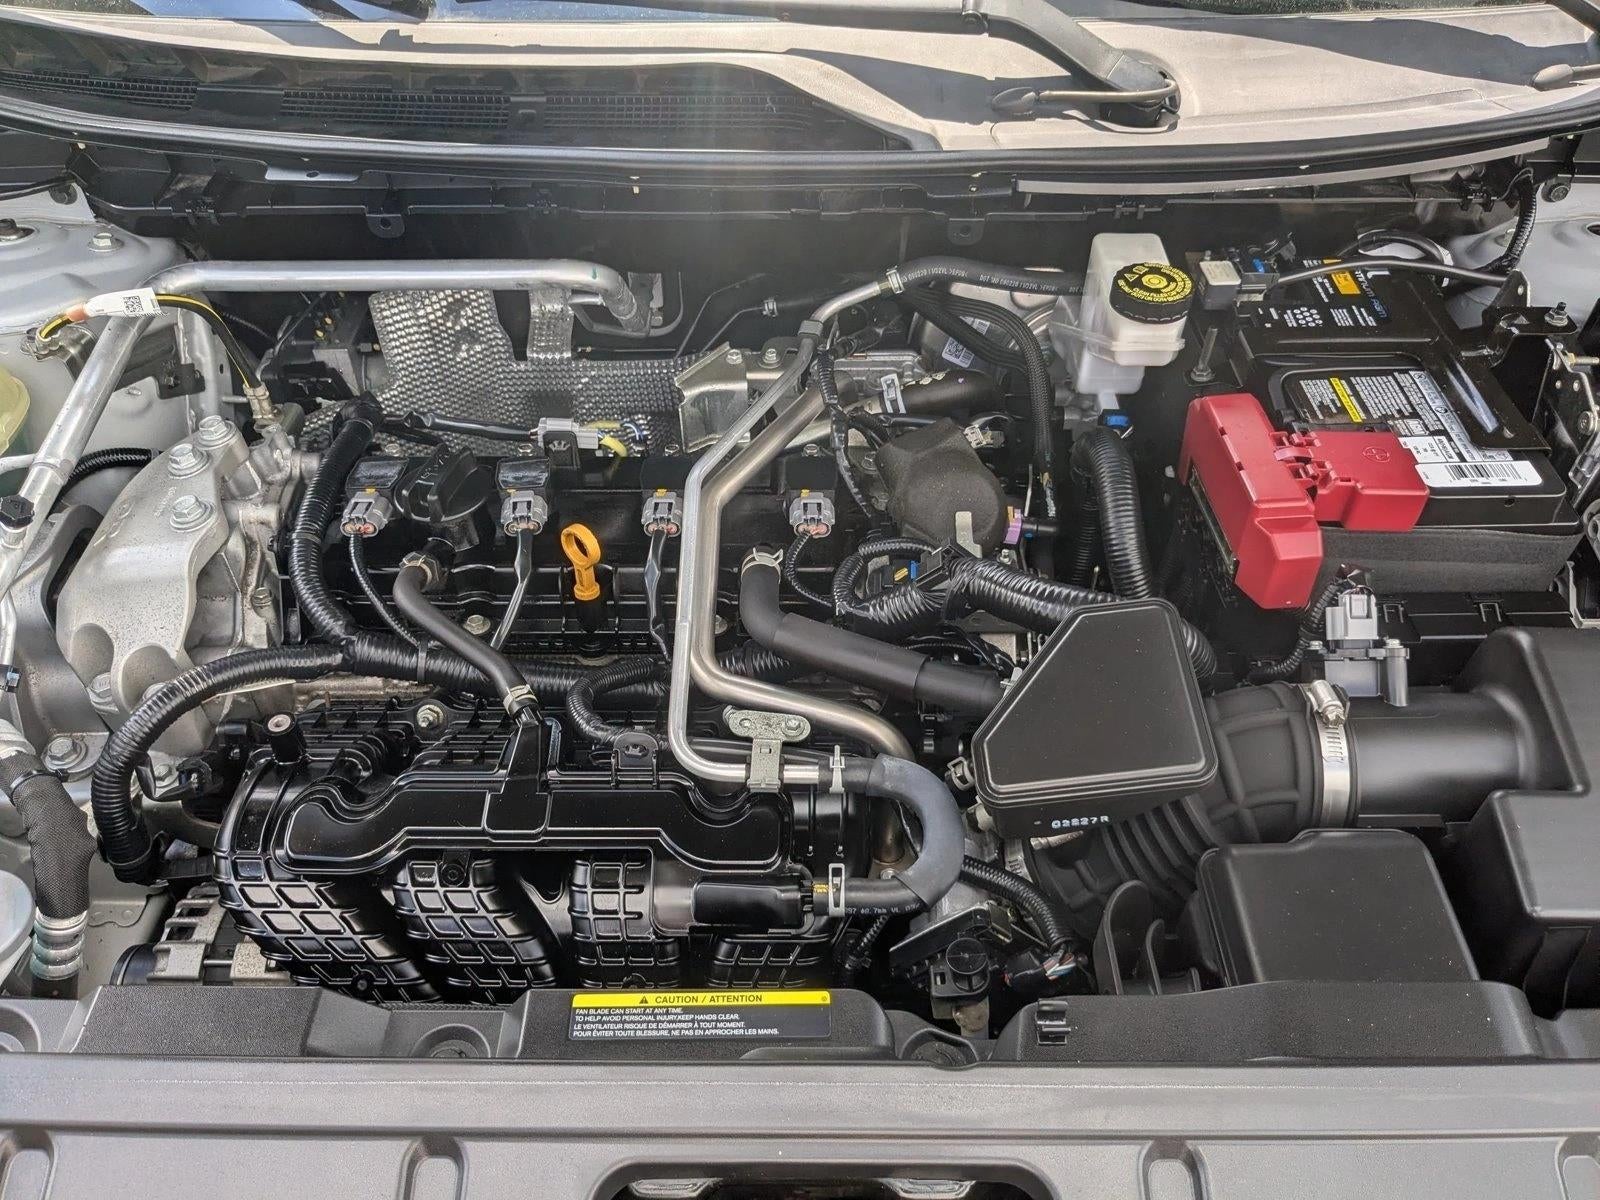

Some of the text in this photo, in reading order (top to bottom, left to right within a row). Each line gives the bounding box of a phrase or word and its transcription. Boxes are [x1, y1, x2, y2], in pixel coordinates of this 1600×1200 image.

[655, 994, 763, 1004] CAUTION / ATTENTION
[624, 1022, 647, 1030] RISQUE
[658, 1021, 692, 1029] DÉMARRER
[693, 1020, 699, 1028] À
[592, 1029, 614, 1037] ÉVITER
[636, 1029, 670, 1037] BLESSURE,
[704, 1028, 744, 1036] APPROCHER
